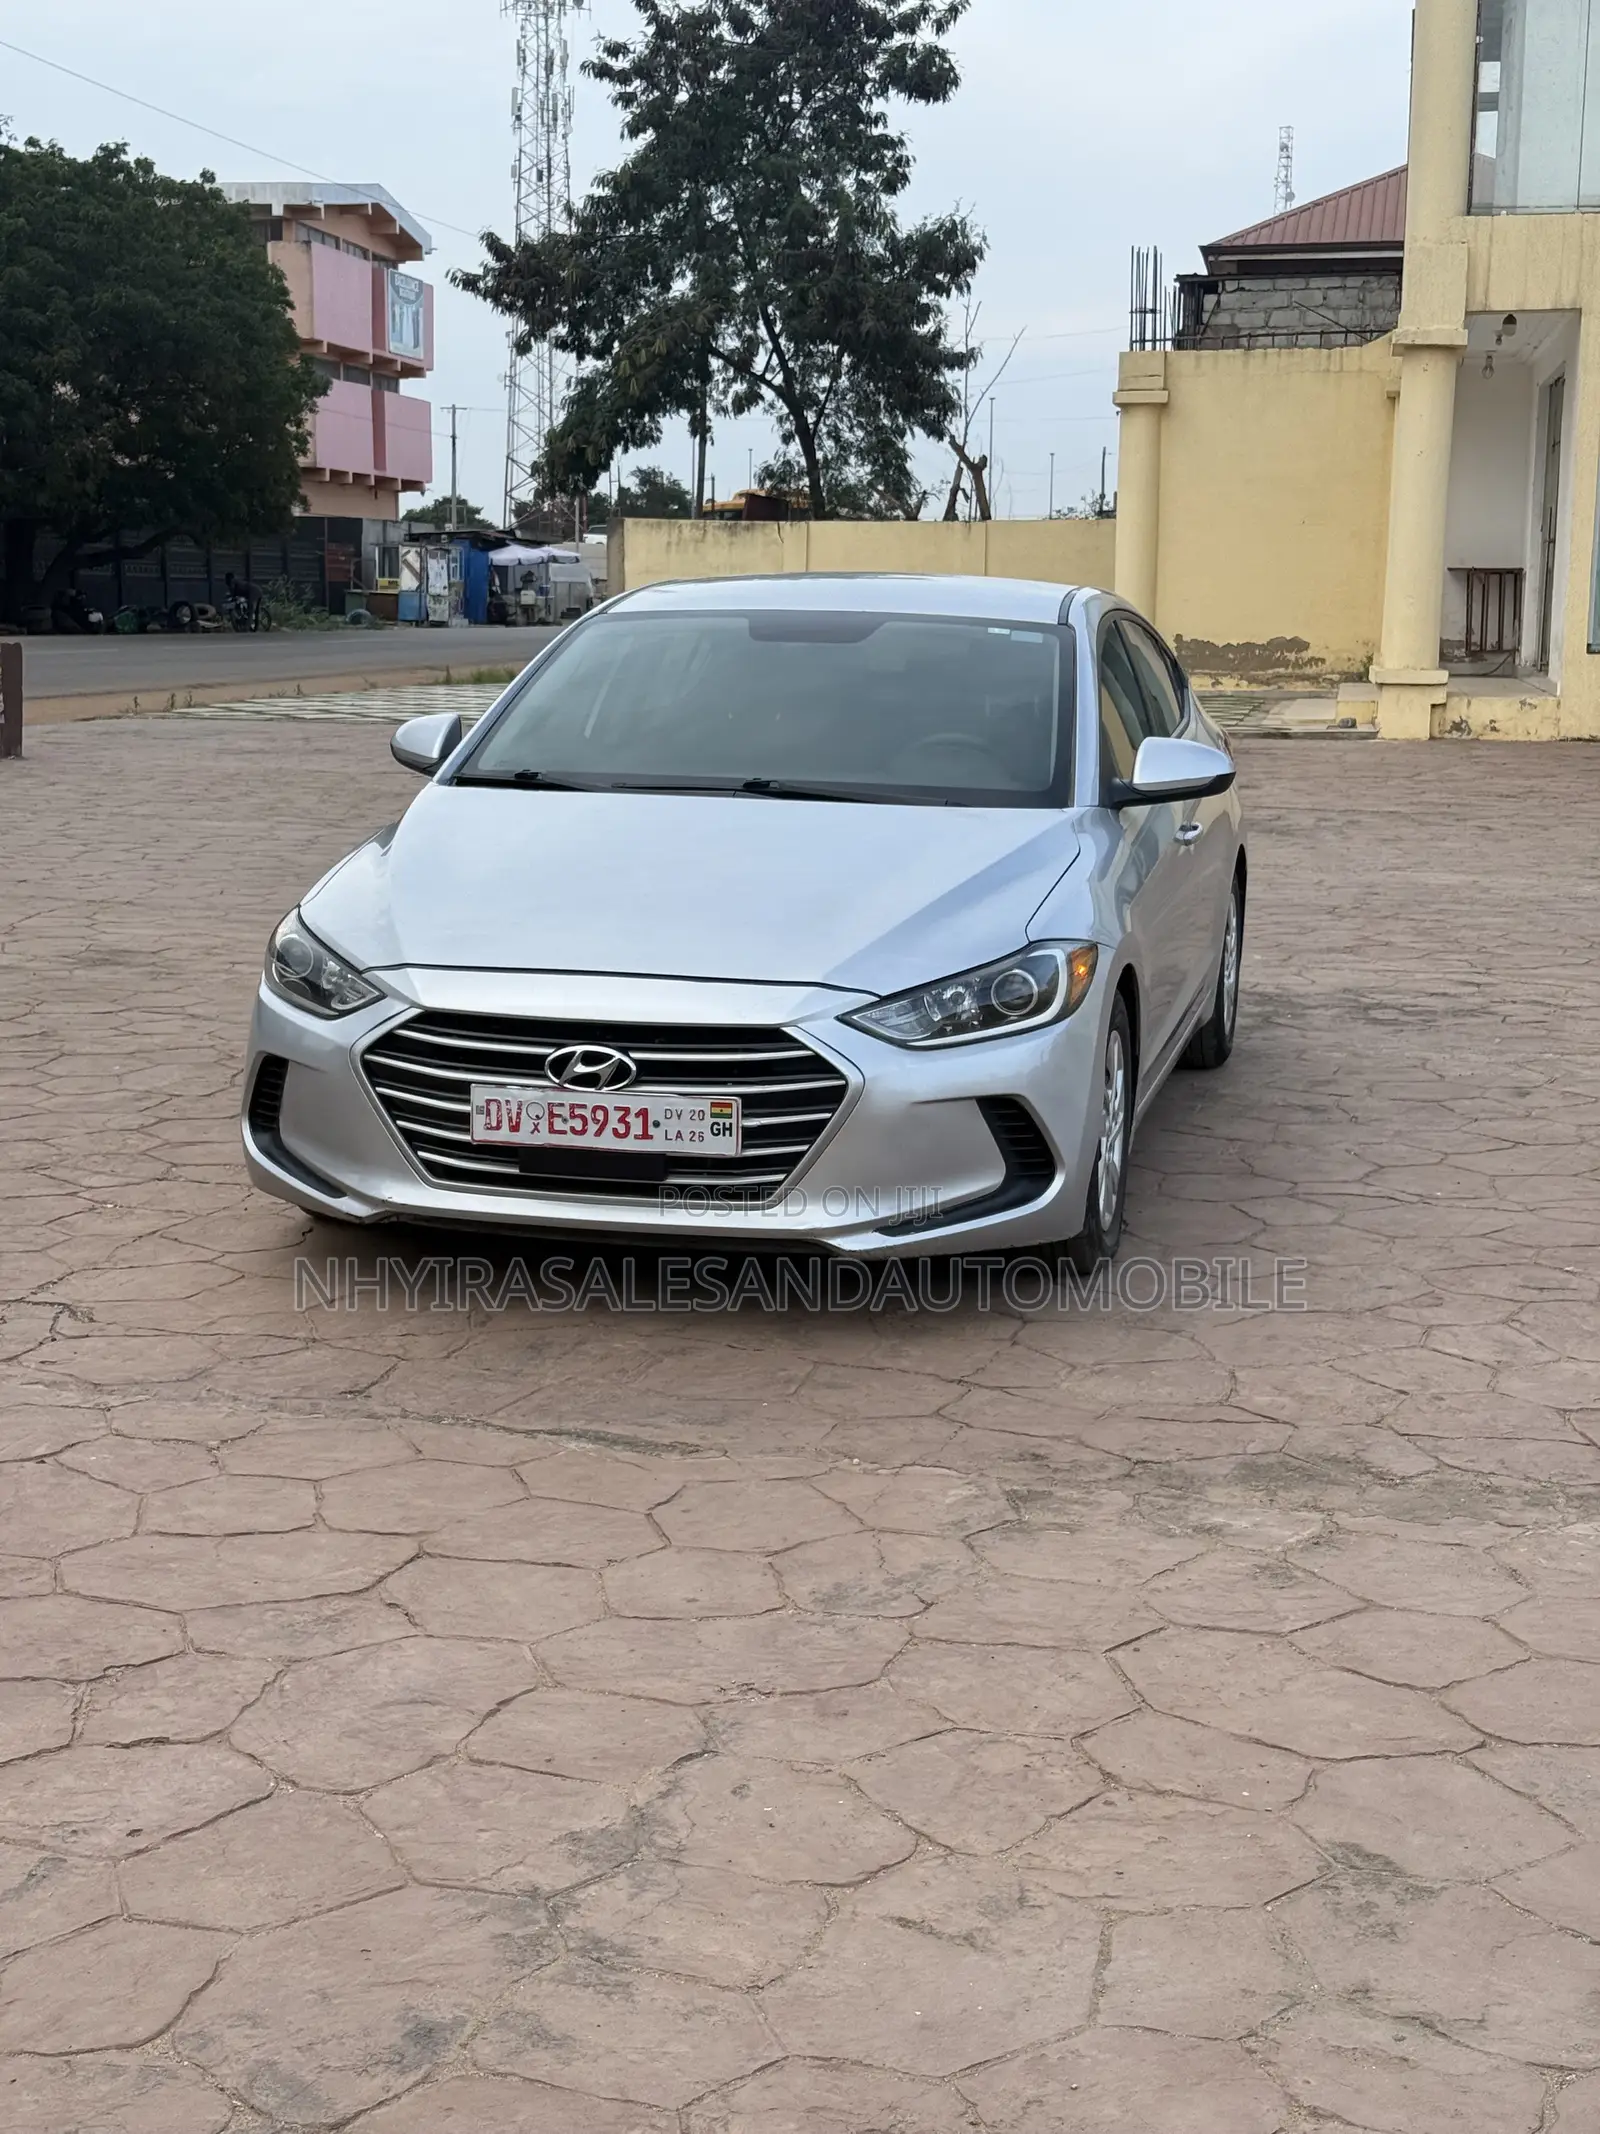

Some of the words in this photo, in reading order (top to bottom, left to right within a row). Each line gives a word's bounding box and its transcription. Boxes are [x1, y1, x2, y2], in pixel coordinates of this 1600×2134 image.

[483, 1098, 523, 1133] DV
[547, 1101, 654, 1141] E5931
[664, 1107, 684, 1121] DV
[689, 1109, 706, 1122] 20
[664, 1129, 684, 1142] LA
[688, 1130, 705, 1143] 26
[710, 1120, 733, 1138] GH
